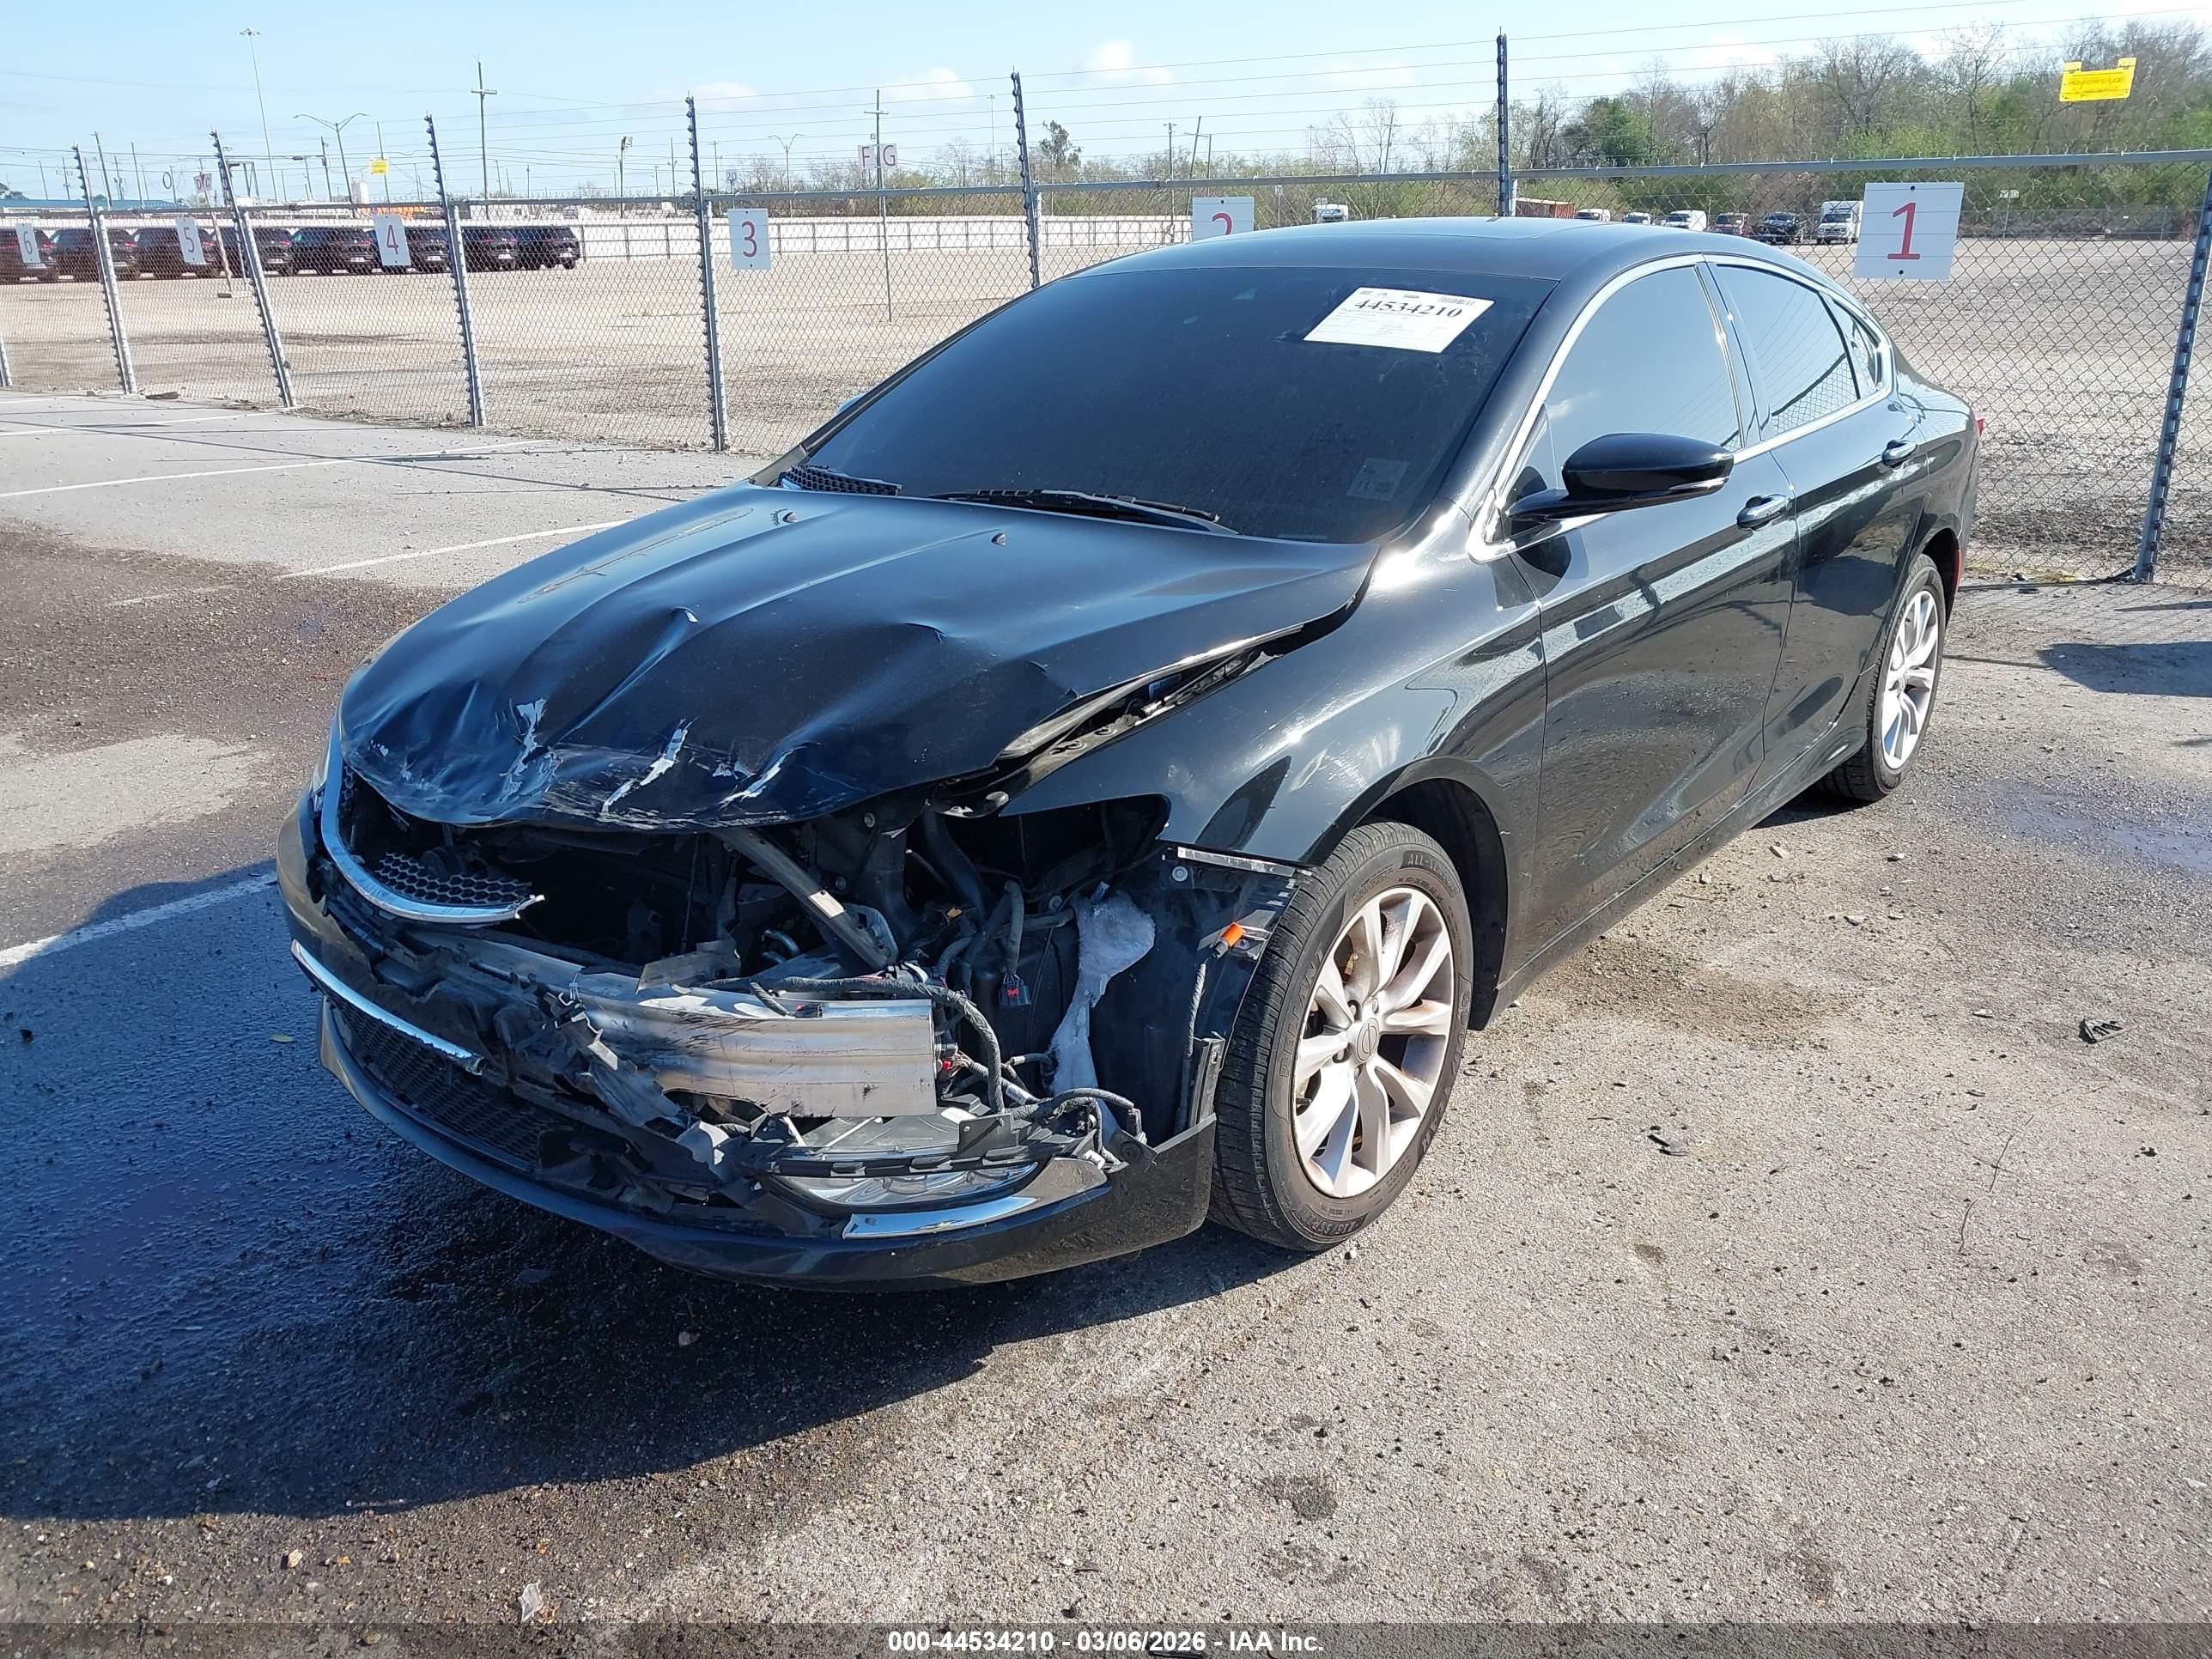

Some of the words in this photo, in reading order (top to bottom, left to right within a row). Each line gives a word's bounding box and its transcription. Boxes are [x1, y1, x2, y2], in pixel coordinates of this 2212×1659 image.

[861, 146, 870, 167] F
[883, 144, 896, 167] G
[23, 230, 33, 255] 6
[183, 226, 195, 253] 5
[385, 224, 399, 255] 4
[741, 221, 757, 258] 3
[1887, 202, 1921, 260] 1
[1354, 299, 1463, 318] 44534210
